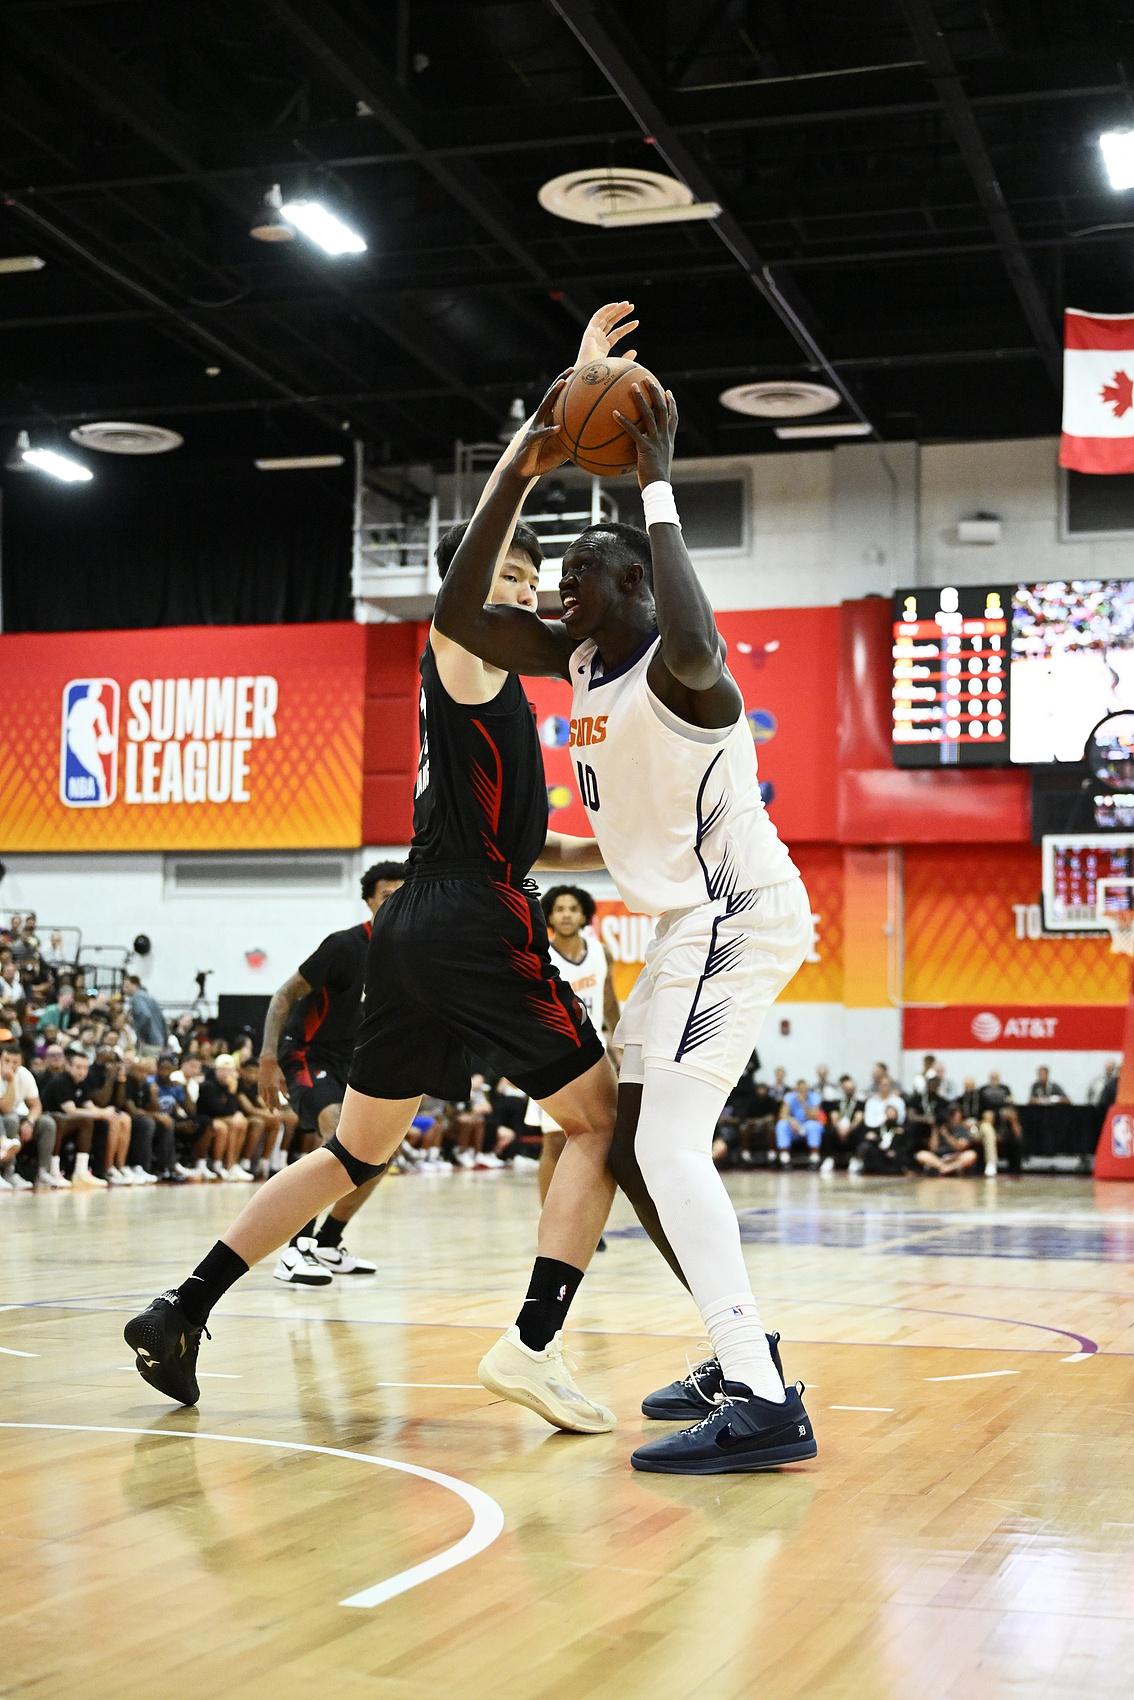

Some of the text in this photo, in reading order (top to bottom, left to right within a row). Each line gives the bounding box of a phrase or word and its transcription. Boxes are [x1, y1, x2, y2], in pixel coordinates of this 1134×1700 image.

[126, 676, 278, 742] SUMMER
[569, 715, 609, 747] SUNS
[125, 740, 252, 804] LEAGUE
[576, 760, 600, 812] 10
[1003, 1017, 1058, 1038] AT&T
